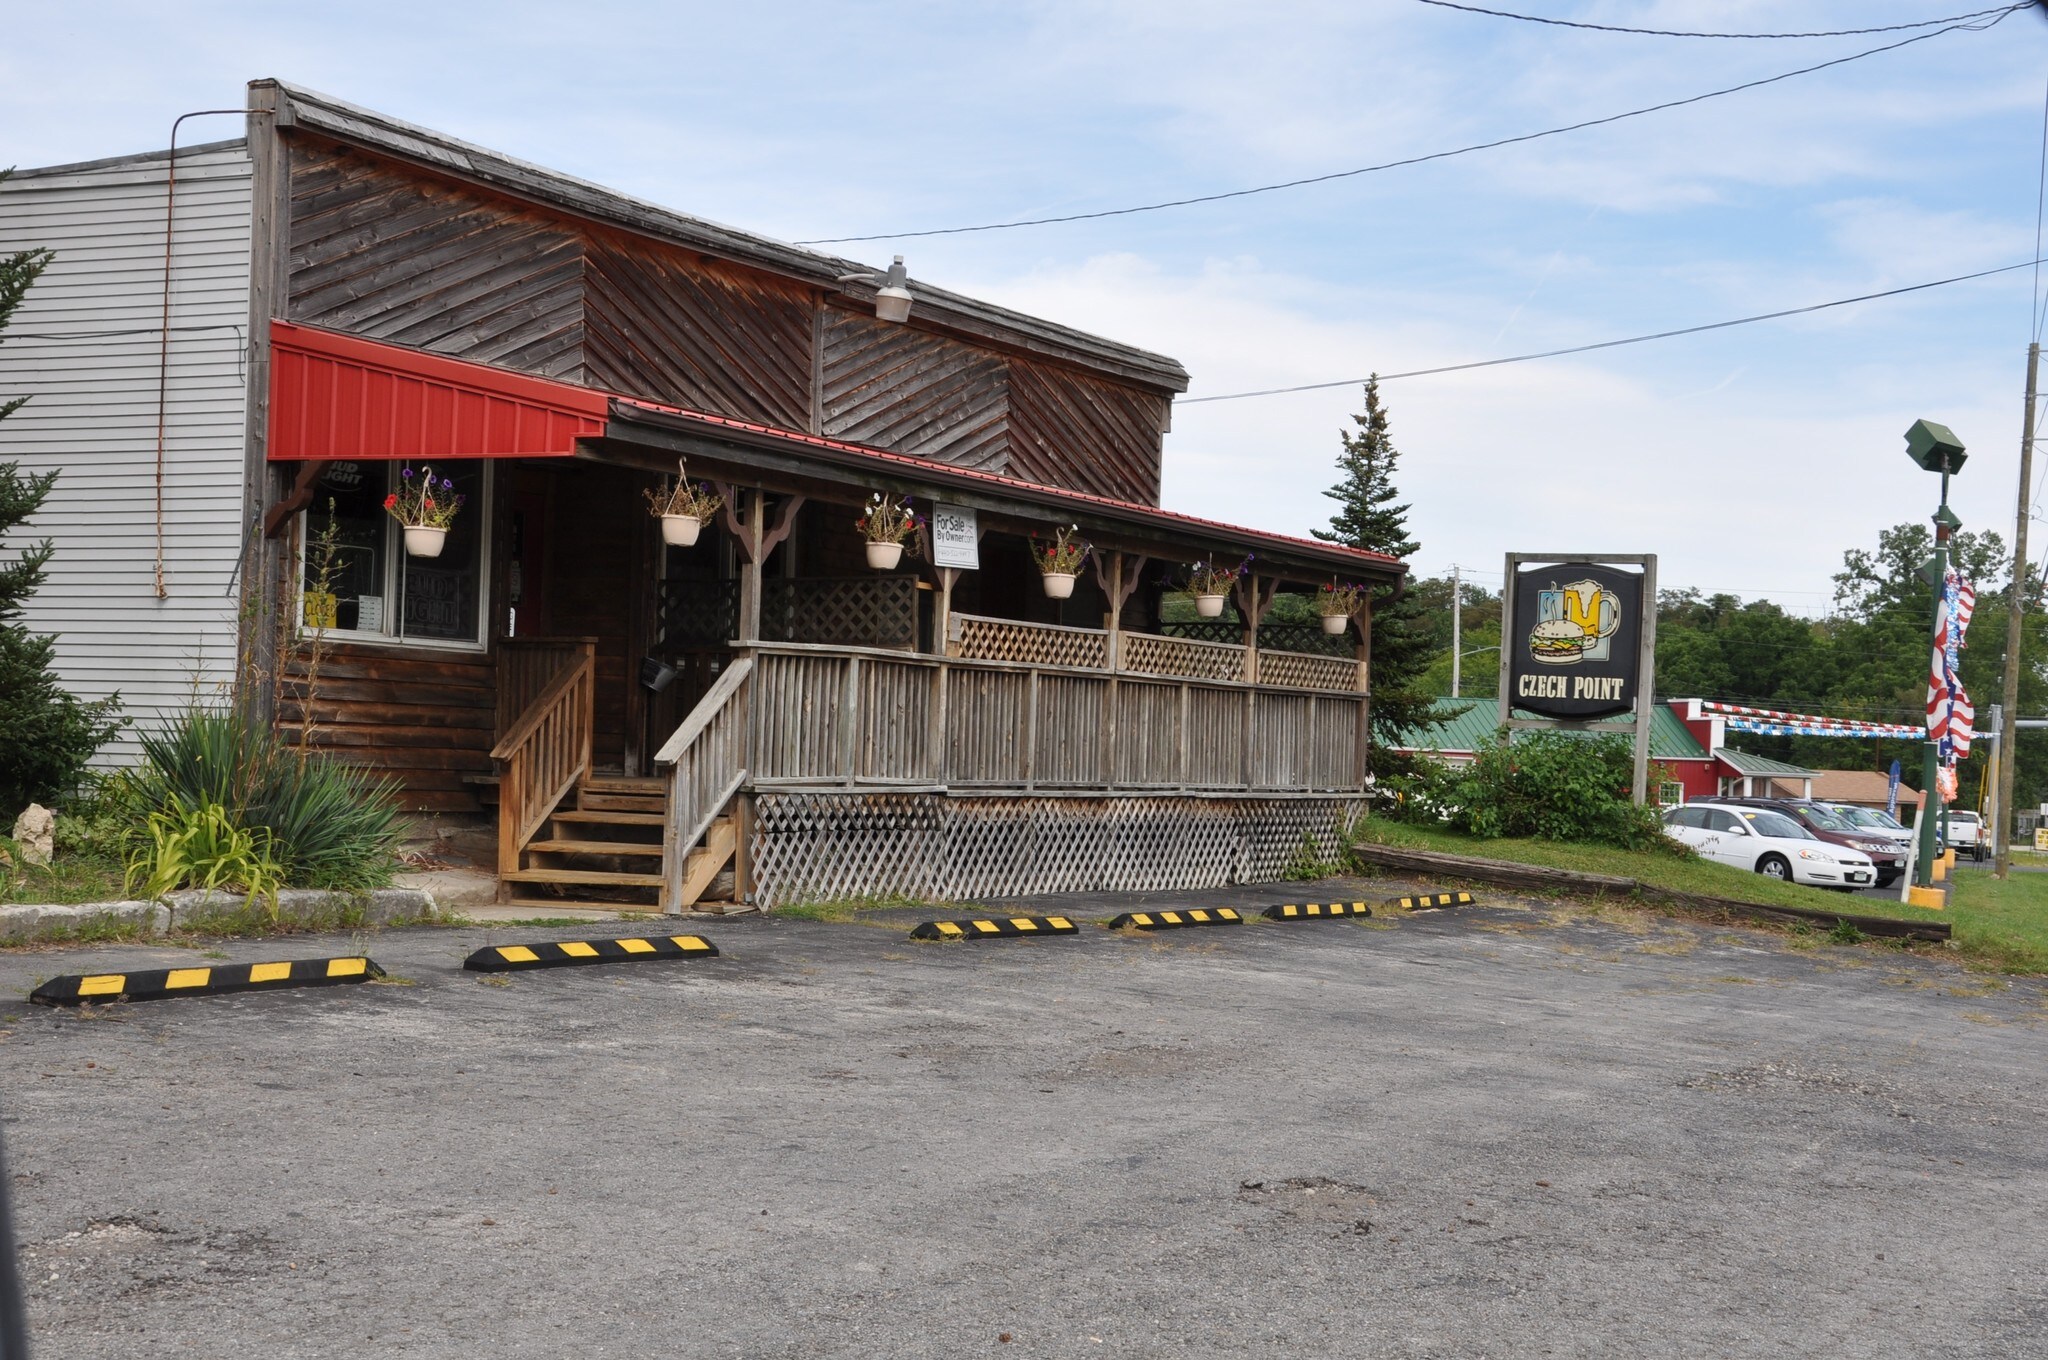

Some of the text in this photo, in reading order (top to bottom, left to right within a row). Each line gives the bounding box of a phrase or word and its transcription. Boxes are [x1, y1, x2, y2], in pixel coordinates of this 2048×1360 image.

[936, 514, 965, 532] For Sale
[937, 530, 945, 542] By
[1519, 674, 1624, 700] CZECH POINT
